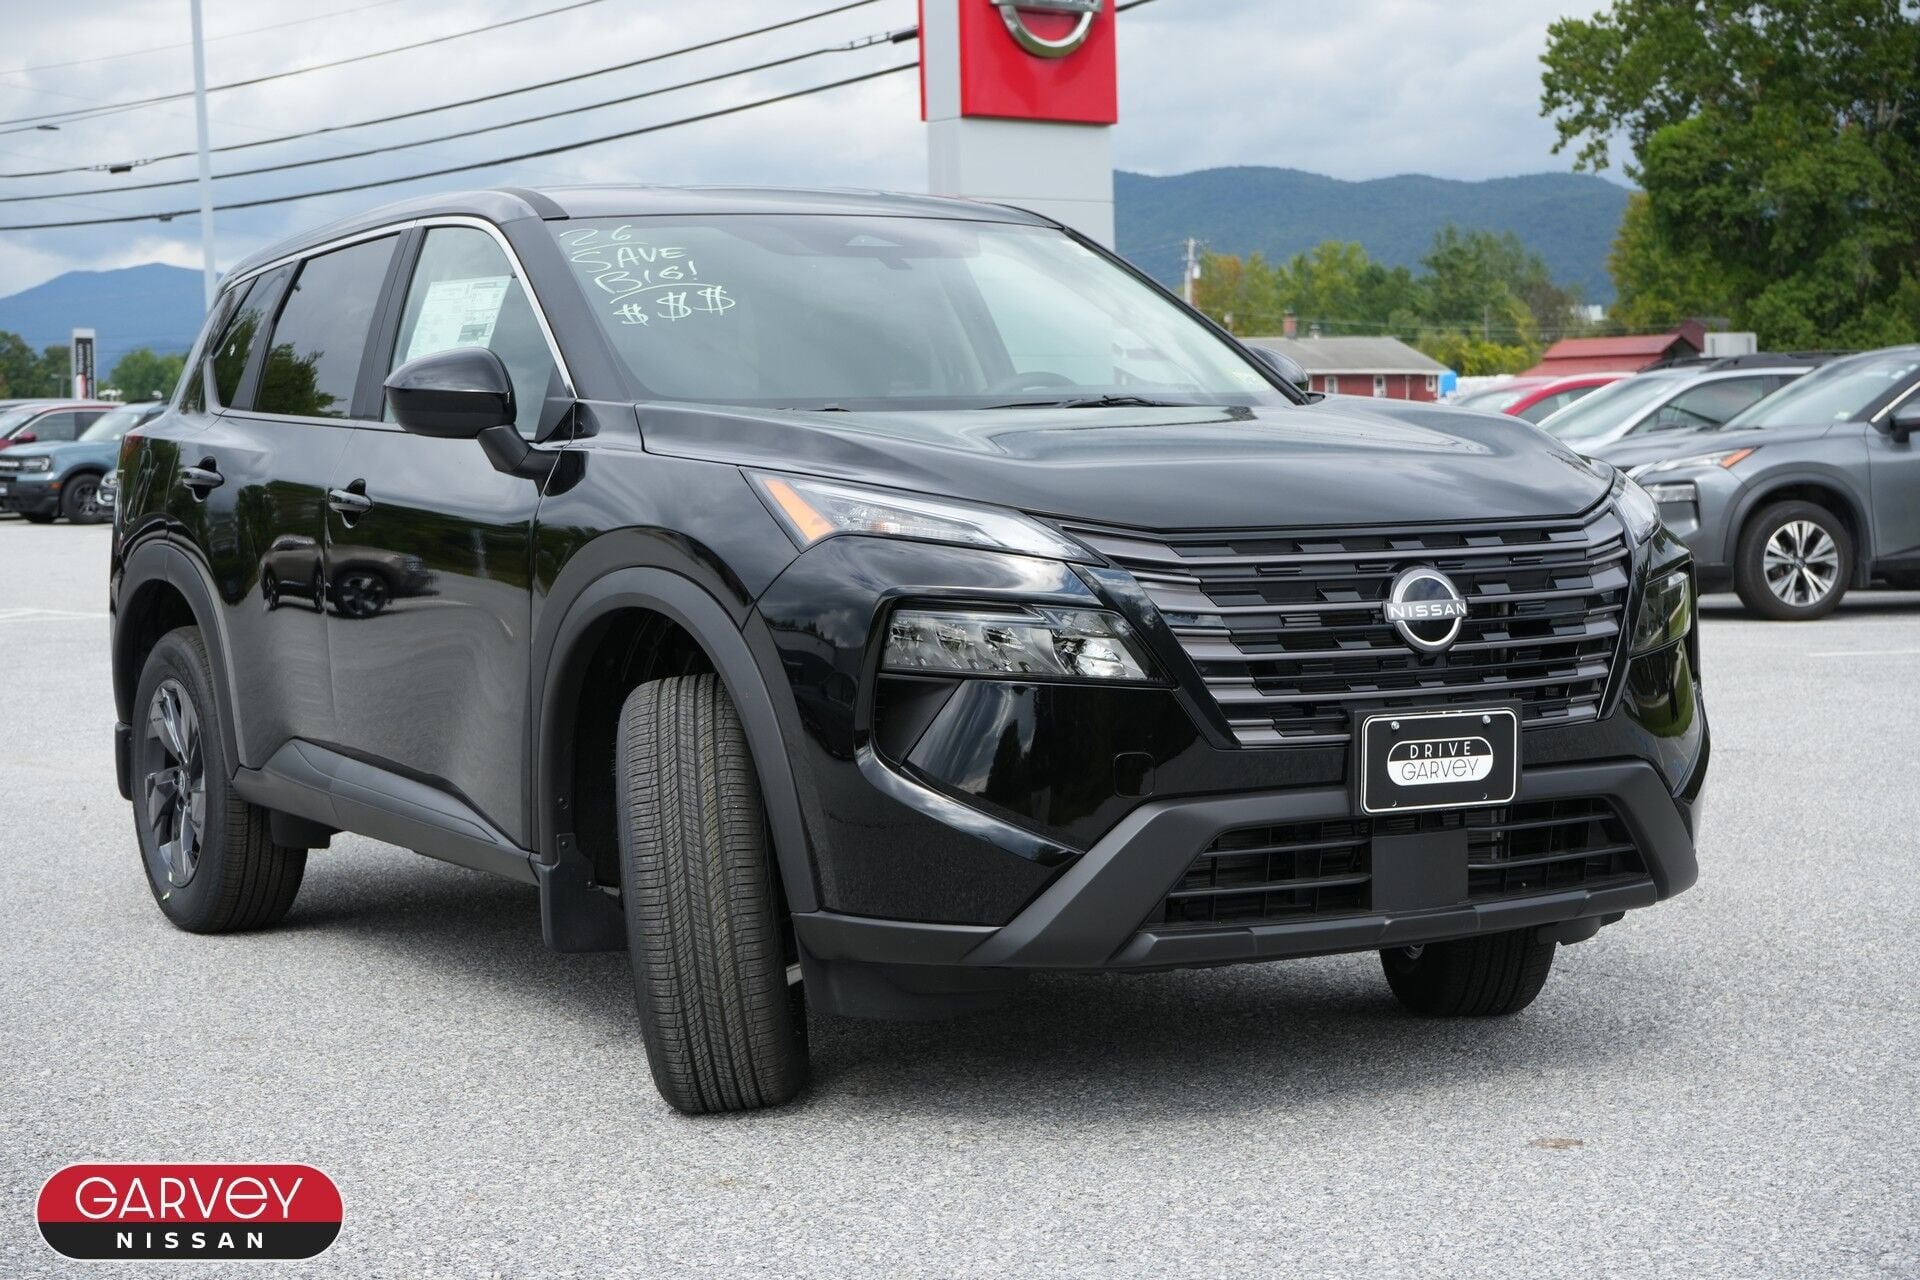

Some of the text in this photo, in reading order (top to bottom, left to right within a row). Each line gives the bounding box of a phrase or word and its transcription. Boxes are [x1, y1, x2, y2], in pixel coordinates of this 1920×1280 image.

[570, 247, 687, 273] SAVE
[594, 260, 698, 294] BIG!
[1390, 602, 1467, 618] NISSAN
[1409, 740, 1471, 759] DRIVE
